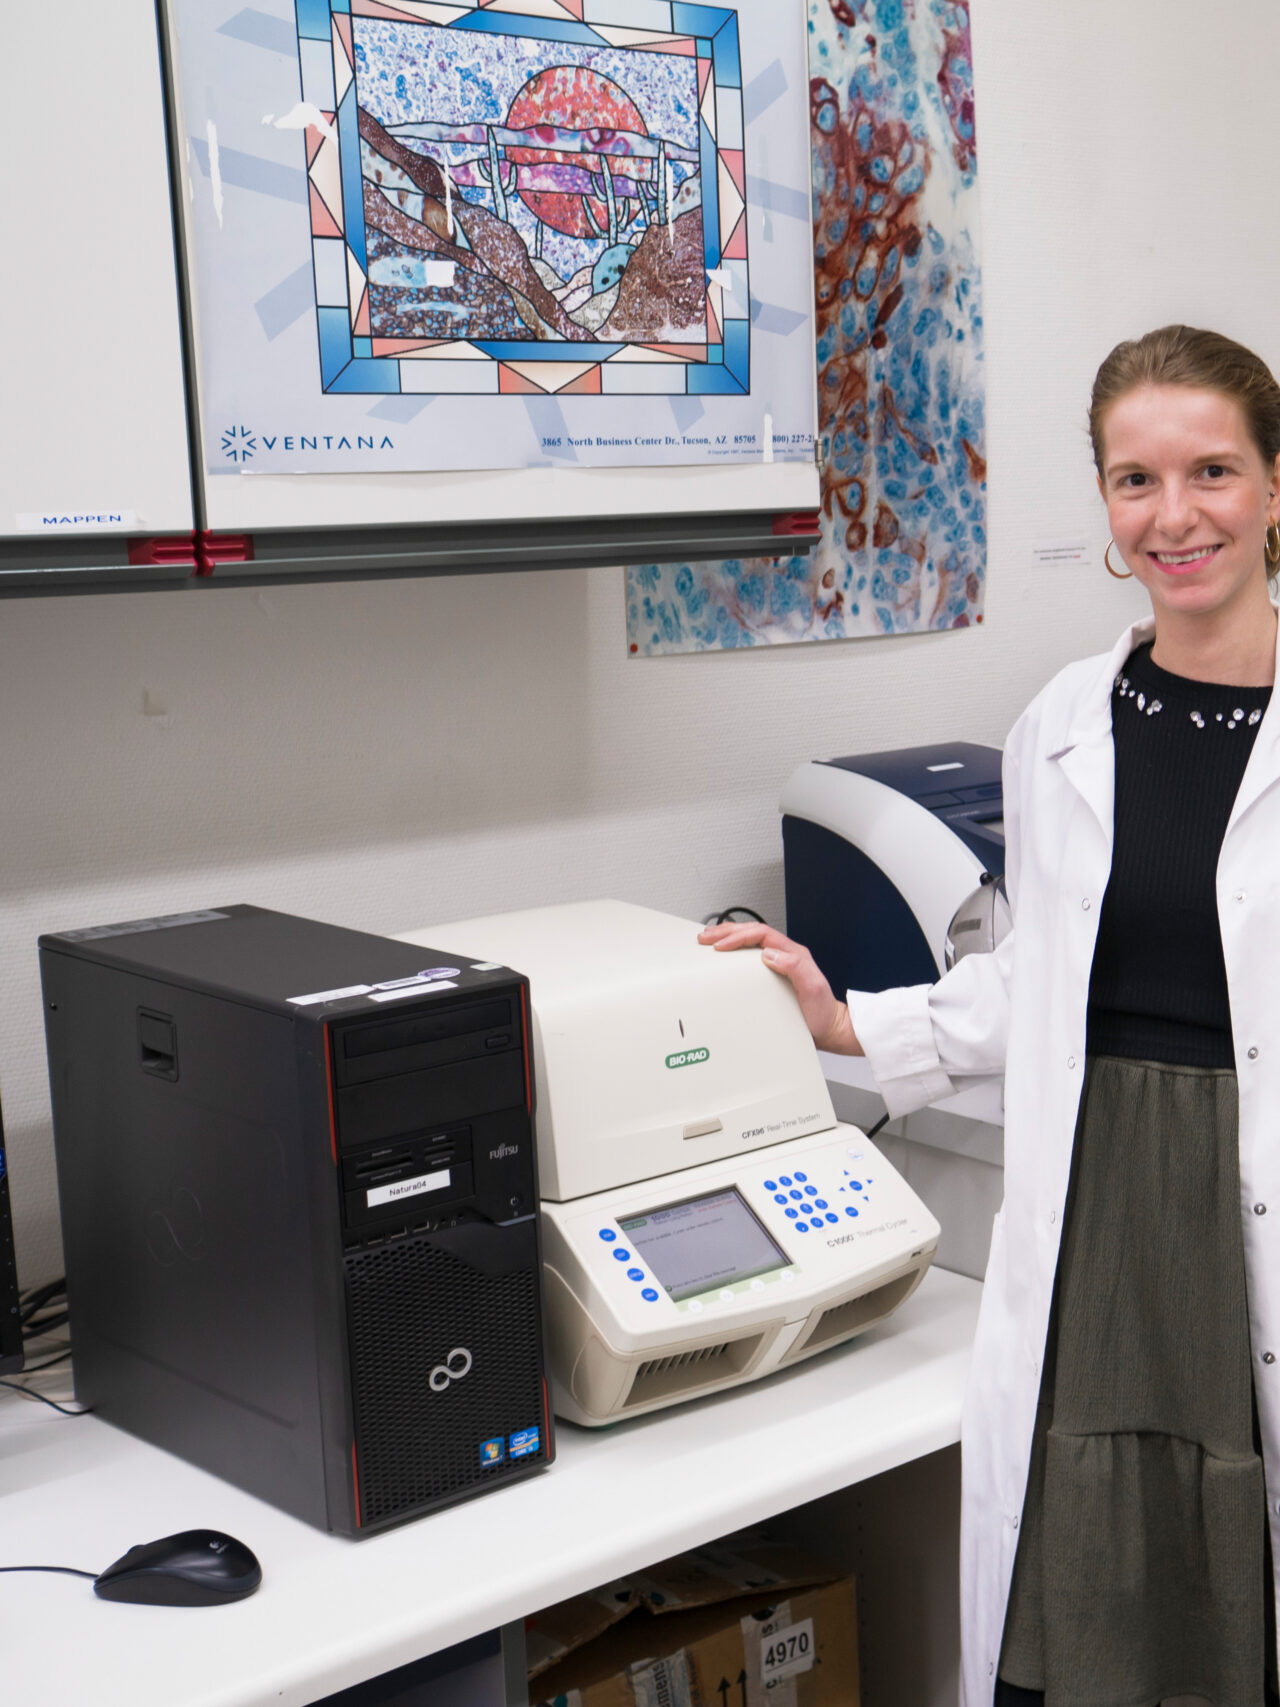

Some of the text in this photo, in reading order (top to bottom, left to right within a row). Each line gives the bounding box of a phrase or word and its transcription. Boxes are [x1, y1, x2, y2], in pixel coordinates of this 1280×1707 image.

[262, 435, 394, 450] VENTANA
[541, 437, 562, 447] 3865
[567, 437, 593, 447] North
[596, 437, 632, 446] Business
[634, 436, 662, 446] Center
[714, 435, 727, 444] AZ
[734, 435, 756, 444] 85705
[772, 434, 789, 444] 800)
[42, 515, 122, 525] MAPPEN
[489, 1143, 519, 1160] FUJITSU
[389, 1180, 427, 1197] Natura04
[765, 1631, 809, 1667] 4970
